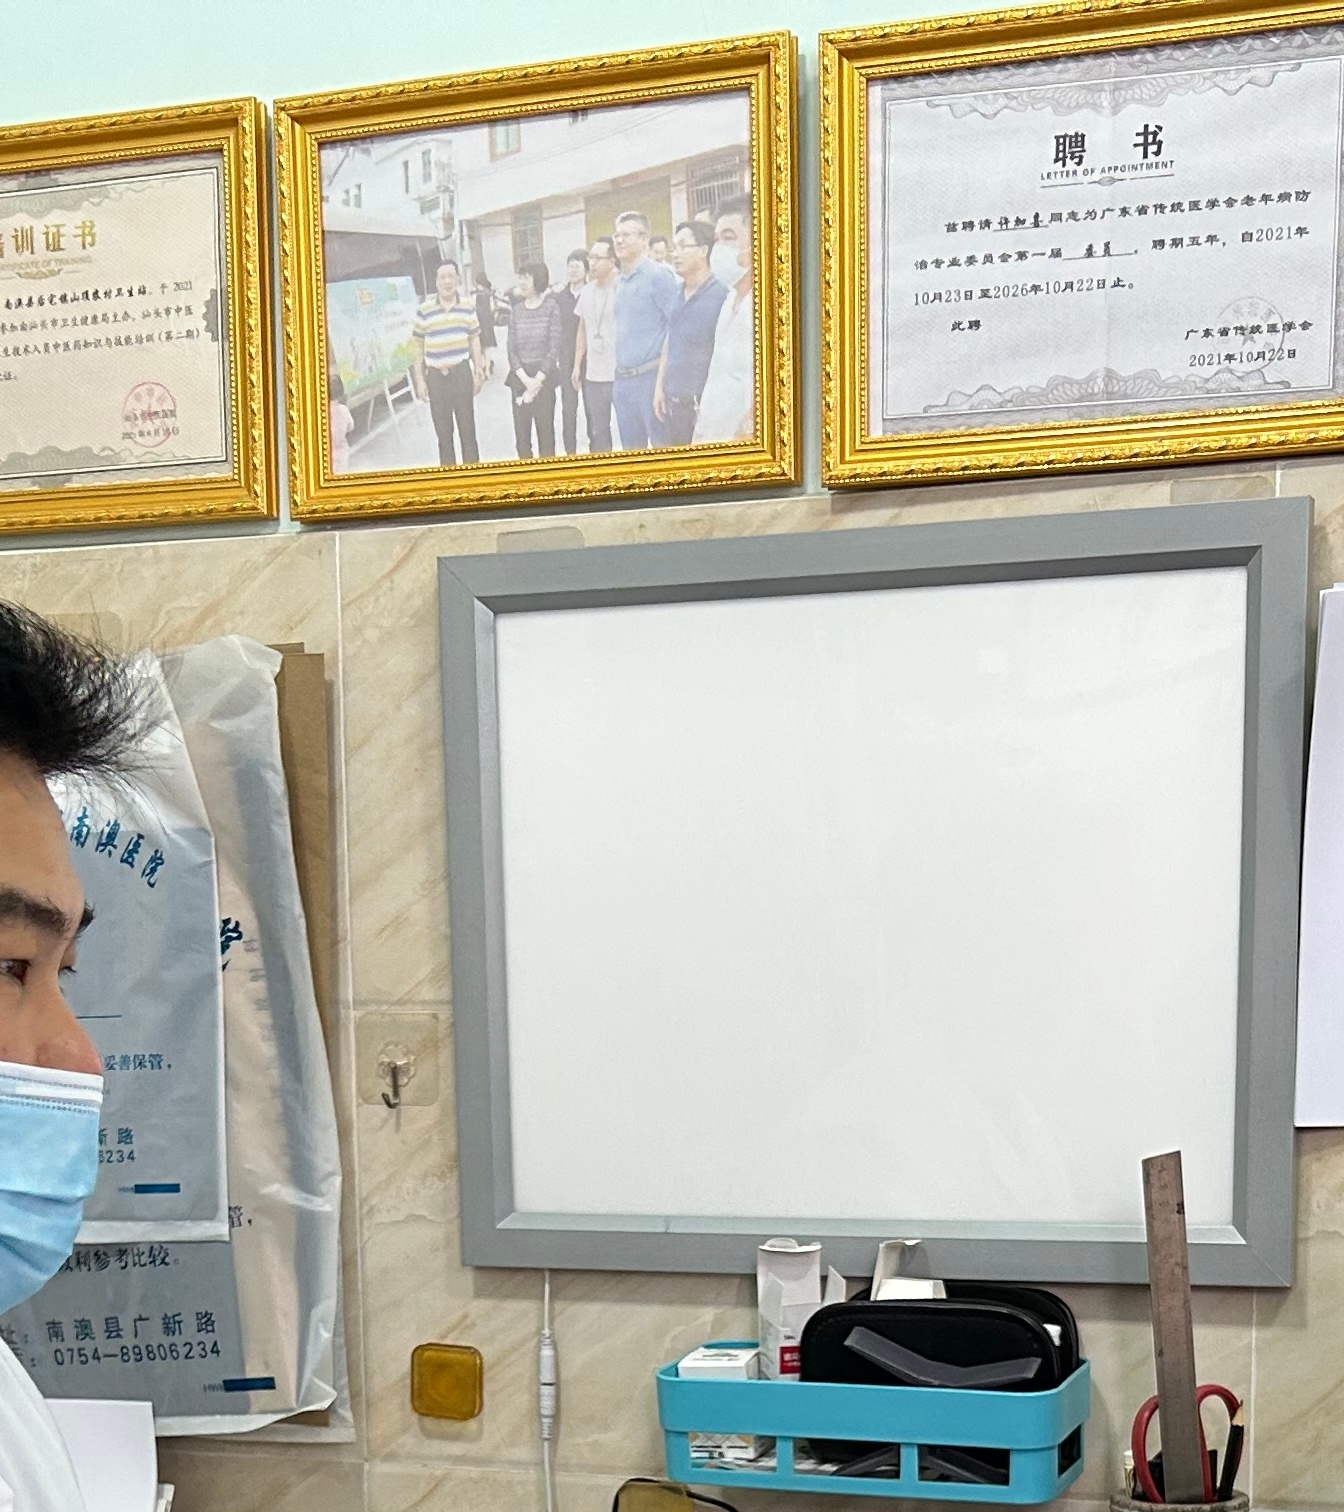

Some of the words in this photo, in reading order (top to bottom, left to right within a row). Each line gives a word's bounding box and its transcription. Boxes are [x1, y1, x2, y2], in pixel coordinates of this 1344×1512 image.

[1052, 123, 1164, 168] 聘书
[1040, 169, 1079, 182] LETTER
[1082, 166, 1096, 178] OF
[1100, 159, 1175, 176] APPOINTMENT
[1241, 226, 1310, 244] 自2021年
[951, 317, 982, 333] 此聘
[1184, 319, 1314, 341] 广东省传统医学会
[1189, 348, 1297, 368] 2021年10月22日
[69, 806, 166, 888] 南澳医院
[45, 1310, 217, 1344] 南澳县广新路
